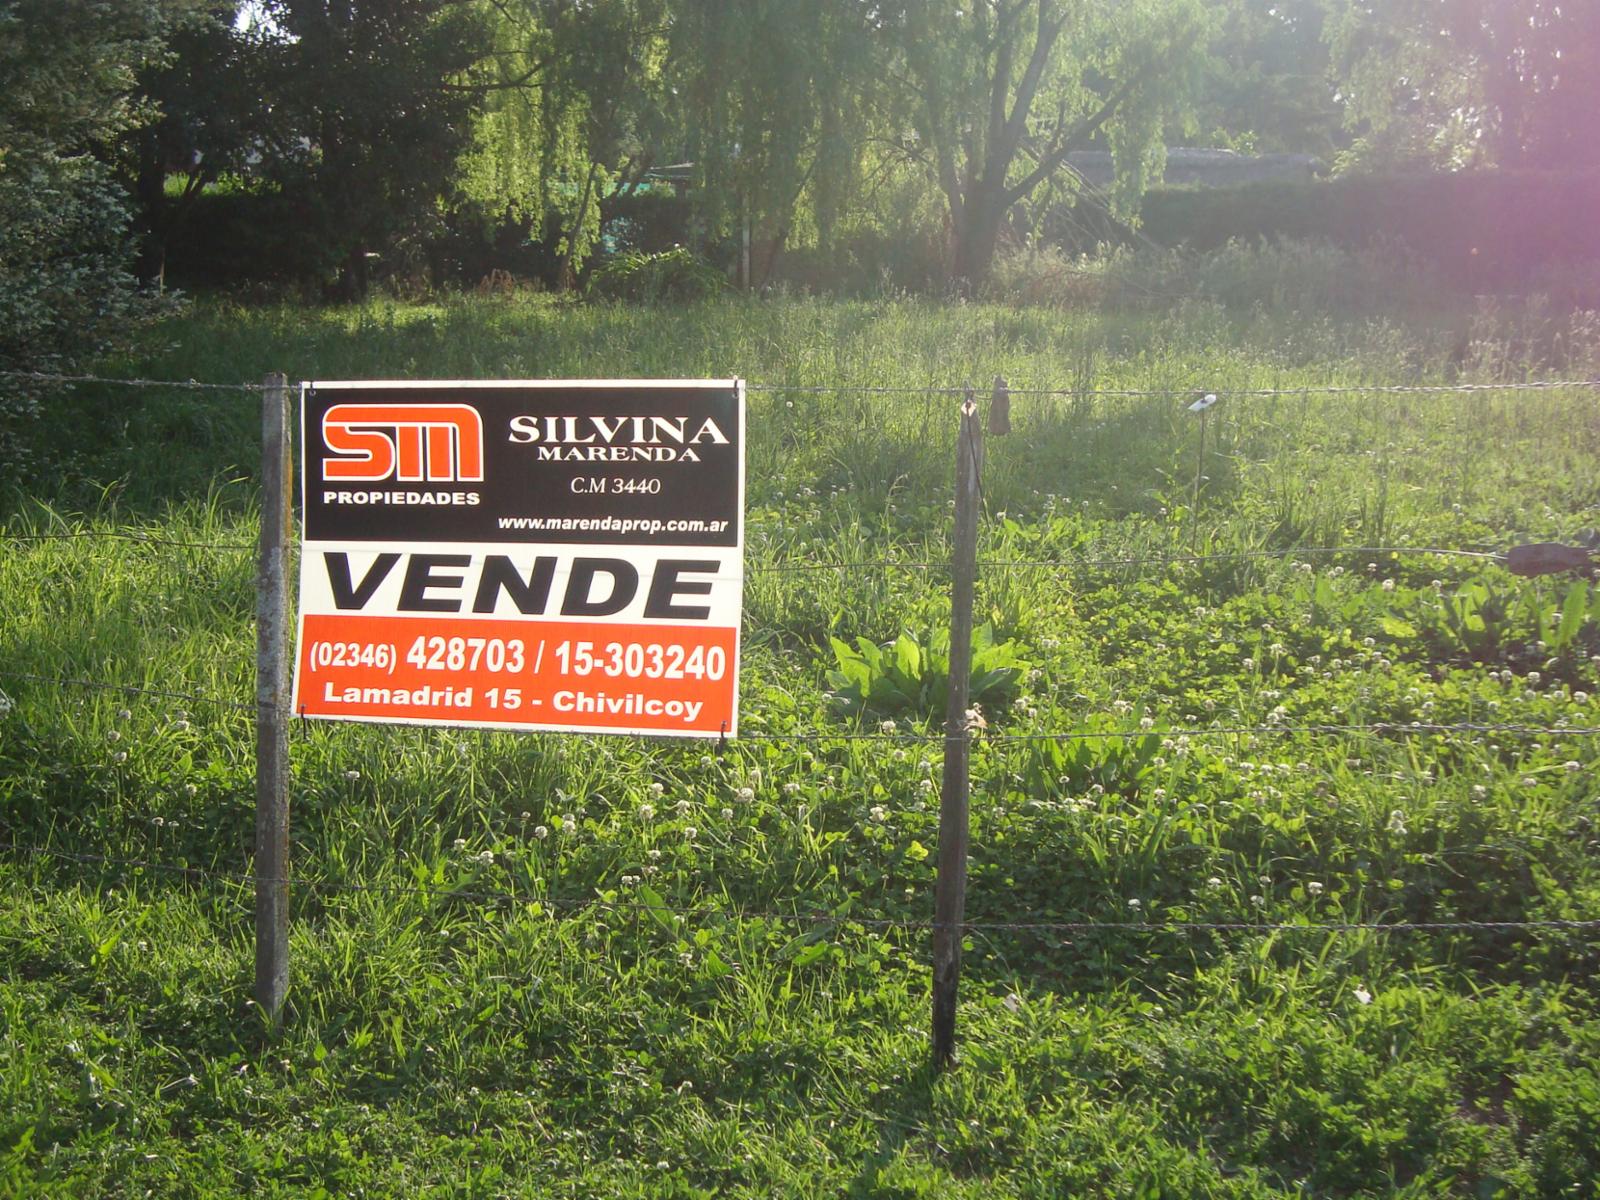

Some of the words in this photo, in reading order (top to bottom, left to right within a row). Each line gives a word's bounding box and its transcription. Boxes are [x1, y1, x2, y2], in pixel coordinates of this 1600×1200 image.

[508, 415, 730, 445] SILVINA
[537, 446, 701, 462] MARENDA
[570, 477, 606, 493] C.M
[611, 478, 661, 494] 3440
[323, 491, 480, 505] PROPIEDADES
[498, 516, 728, 534] www.marendaprop.com.ar
[323, 551, 721, 620] VENDE
[310, 641, 397, 675] (02346)
[406, 636, 525, 673] 428703
[534, 640, 545, 674] /
[555, 640, 726, 681] 15-303240
[324, 682, 473, 707] Lamadrid
[484, 687, 522, 709] 15
[553, 690, 704, 723] Chivilcoy
